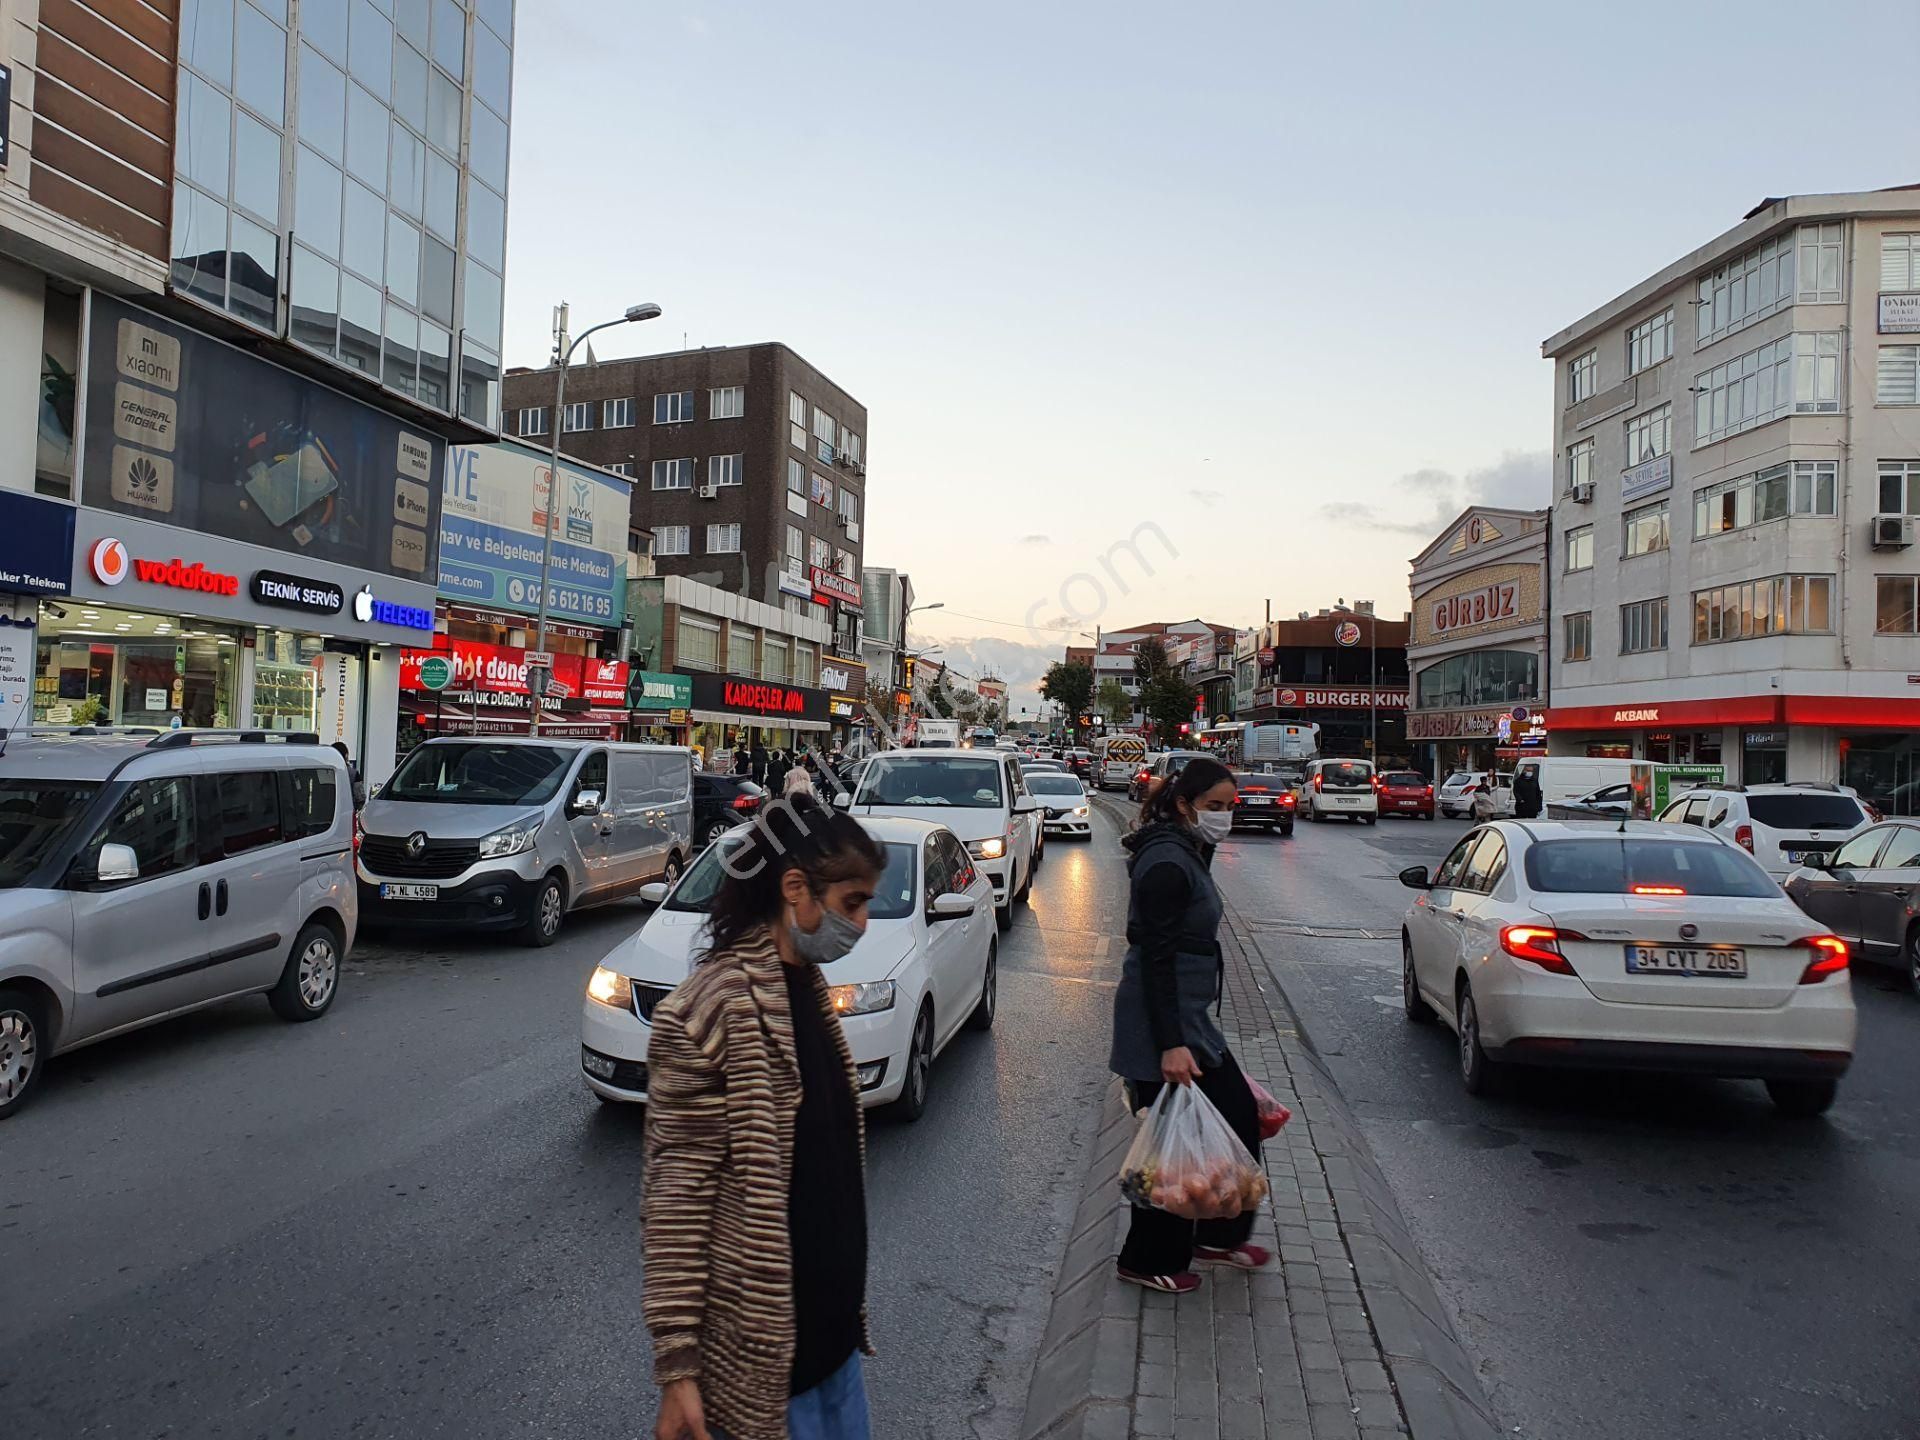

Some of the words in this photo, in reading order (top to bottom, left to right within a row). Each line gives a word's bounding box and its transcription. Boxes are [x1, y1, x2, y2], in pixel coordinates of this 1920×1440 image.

[120, 400, 172, 424] GENERAL
[124, 412, 167, 435] MOBILE
[402, 443, 428, 460] SAMSUNG
[126, 489, 159, 505] HUAWEI
[406, 499, 427, 516] iPhone
[569, 505, 592, 522] MYK
[1470, 517, 1481, 544] G
[466, 536, 481, 550] ve
[484, 537, 568, 572] Belgelendme
[569, 557, 609, 579] Merkezi
[23, 574, 66, 590] Telekom
[133, 559, 239, 596] vodafone
[260, 580, 301, 601] TEKNİK
[302, 589, 340, 608] SERVİS
[560, 588, 579, 609] 612
[581, 593, 595, 612] 16
[596, 598, 610, 616] 95
[1435, 585, 1514, 631] GÜRBÜZ
[475, 613, 506, 626] SALONU
[544, 625, 558, 633] AFE
[2, 675, 26, 683] burada
[490, 690, 524, 707] DÜRÜM
[539, 697, 562, 709] YRAN
[724, 681, 783, 715] KARDEŞLER
[783, 690, 804, 713] AVM
[1305, 691, 1371, 706] BURGER
[1614, 709, 1659, 722] AKBANK
[1682, 766, 1723, 774] KUMBARASI
[386, 885, 397, 896] 34
[399, 885, 410, 897] NL
[413, 885, 436, 897] 4589
[1637, 949, 1660, 967] 34
[1666, 951, 1699, 969] CVT
[1706, 952, 1740, 970] 205
